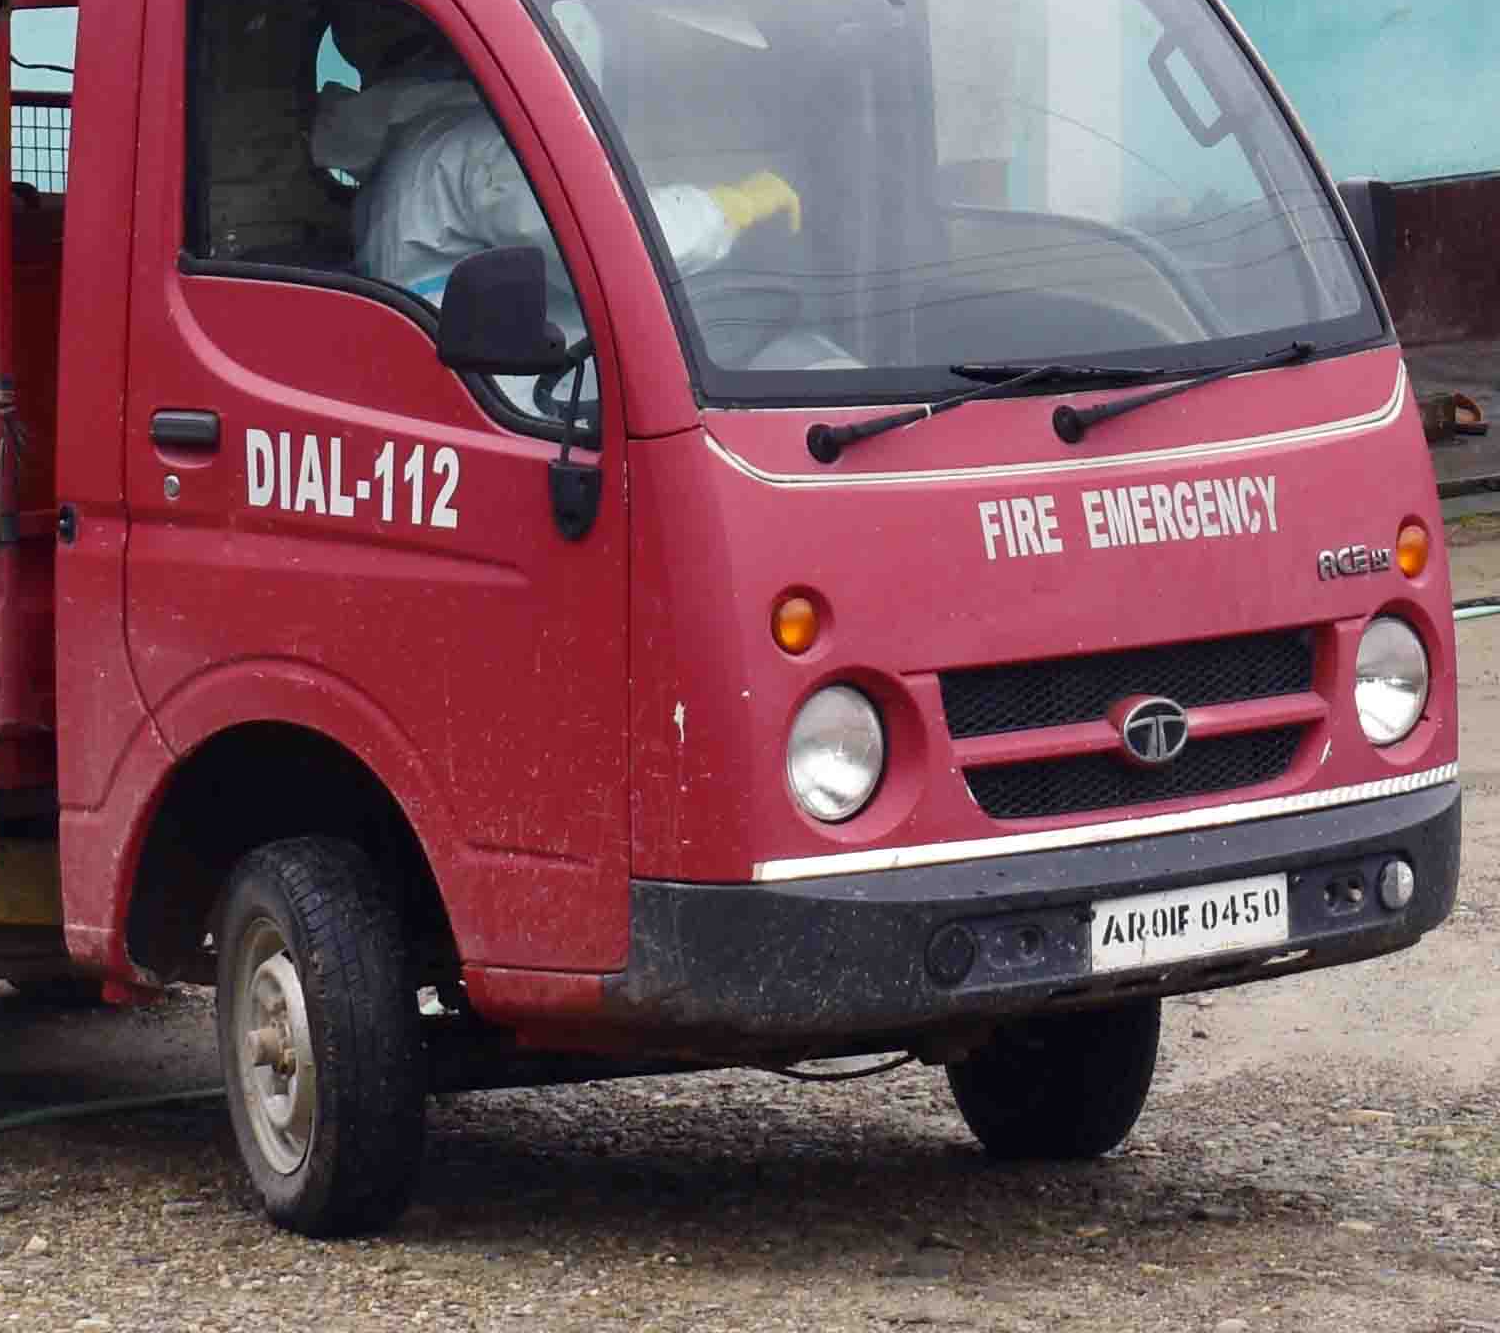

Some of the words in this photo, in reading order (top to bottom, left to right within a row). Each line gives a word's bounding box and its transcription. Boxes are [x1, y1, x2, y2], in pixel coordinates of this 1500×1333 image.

[245, 428, 460, 529] DIAL-112
[978, 495, 1063, 560] FIRE
[1081, 475, 1278, 550] EMERGENCY
[1317, 544, 1366, 581] ACE
[1200, 887, 1281, 931] 0450
